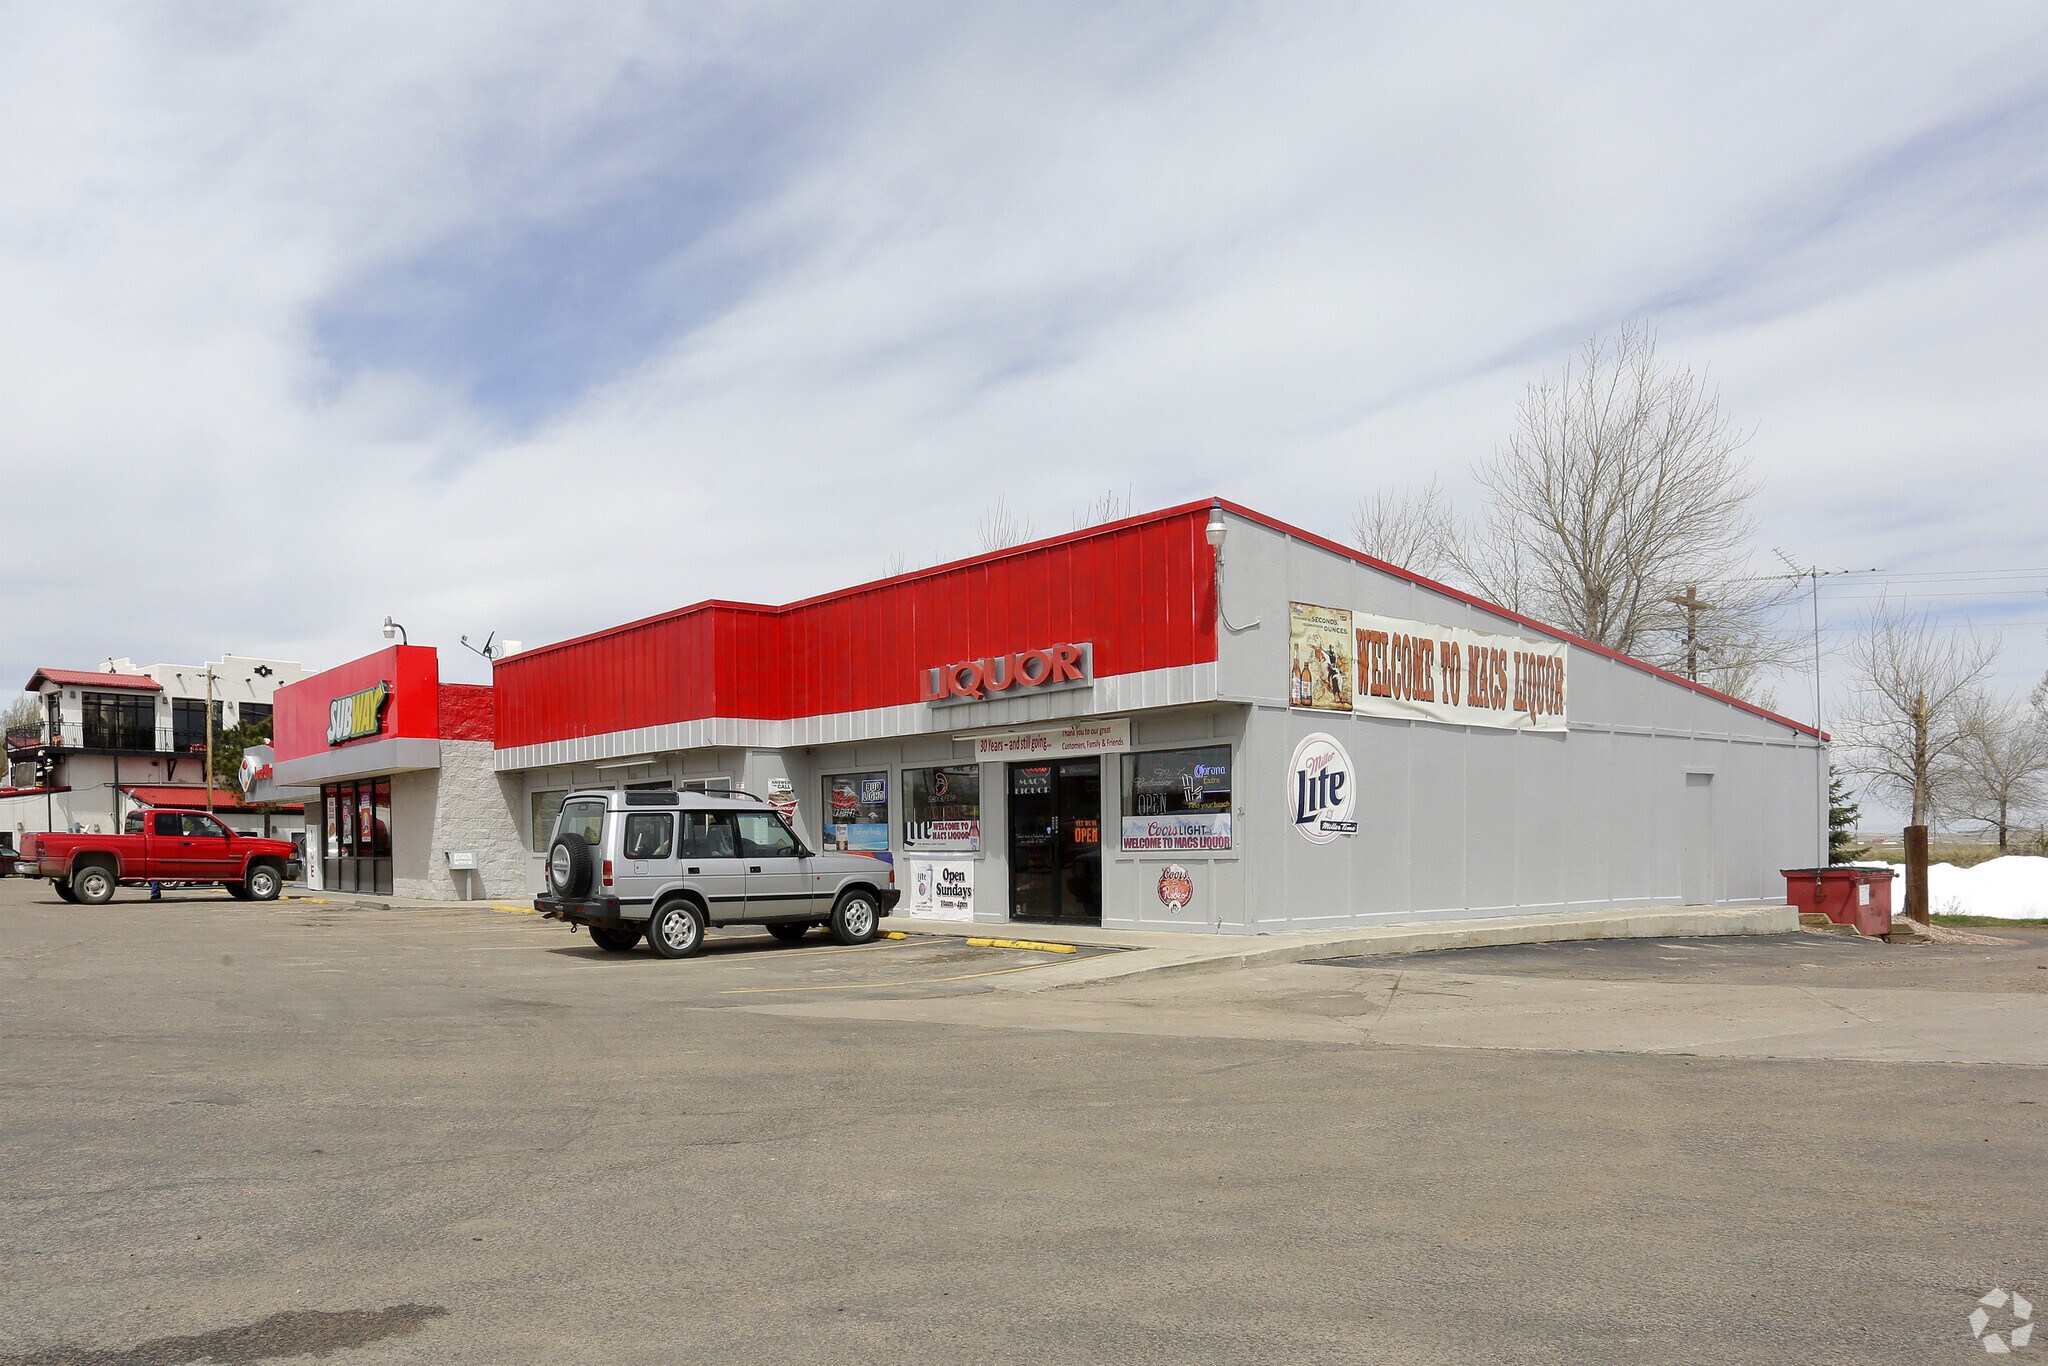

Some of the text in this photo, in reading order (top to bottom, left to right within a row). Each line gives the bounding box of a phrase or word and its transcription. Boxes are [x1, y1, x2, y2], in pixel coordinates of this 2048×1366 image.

[1311, 616, 1339, 626] SECONDS.
[1323, 625, 1349, 635] OUNCES.
[920, 643, 1084, 701] LIQUOR
[1355, 628, 1564, 726] WELCOME TO MACS LIQUOR
[327, 681, 388, 746] SUBWAY
[1062, 728, 1075, 738] Thank
[1075, 728, 1084, 738] you
[1085, 728, 1090, 736] to
[980, 739, 988, 753] 30
[988, 738, 1004, 752] Years
[1009, 735, 1020, 751] and
[1020, 734, 1031, 750] still
[1061, 738, 1124, 750] Customers, Family & Friends
[1306, 752, 1335, 776] Miller
[1194, 764, 1226, 779] Corona
[1019, 778, 1047, 786] MAC'S
[1203, 776, 1220, 785] Extra
[865, 782, 881, 792] BUD
[1014, 787, 1051, 795] LIQUOR
[863, 791, 885, 802] LIGHT
[1296, 766, 1346, 825] Lite
[1138, 793, 1167, 816] OPEN
[1213, 801, 1231, 809] beach
[932, 822, 969, 831] WELCOME TO
[1147, 821, 1206, 836] Coors LIGHT
[1321, 821, 1357, 832] Miller Time
[932, 831, 970, 840] MACS LIQUOR
[1074, 827, 1099, 843] OPEN
[1123, 836, 1231, 849] WELCOME TO MACS LIQUOR
[917, 872, 927, 883] Lite
[942, 867, 966, 884] Open
[1161, 866, 1188, 880] Coors
[936, 882, 972, 900] Sundays
[1162, 885, 1189, 900] Rodeo
[940, 900, 954, 908] 10am
[957, 900, 968, 910] 4pm
